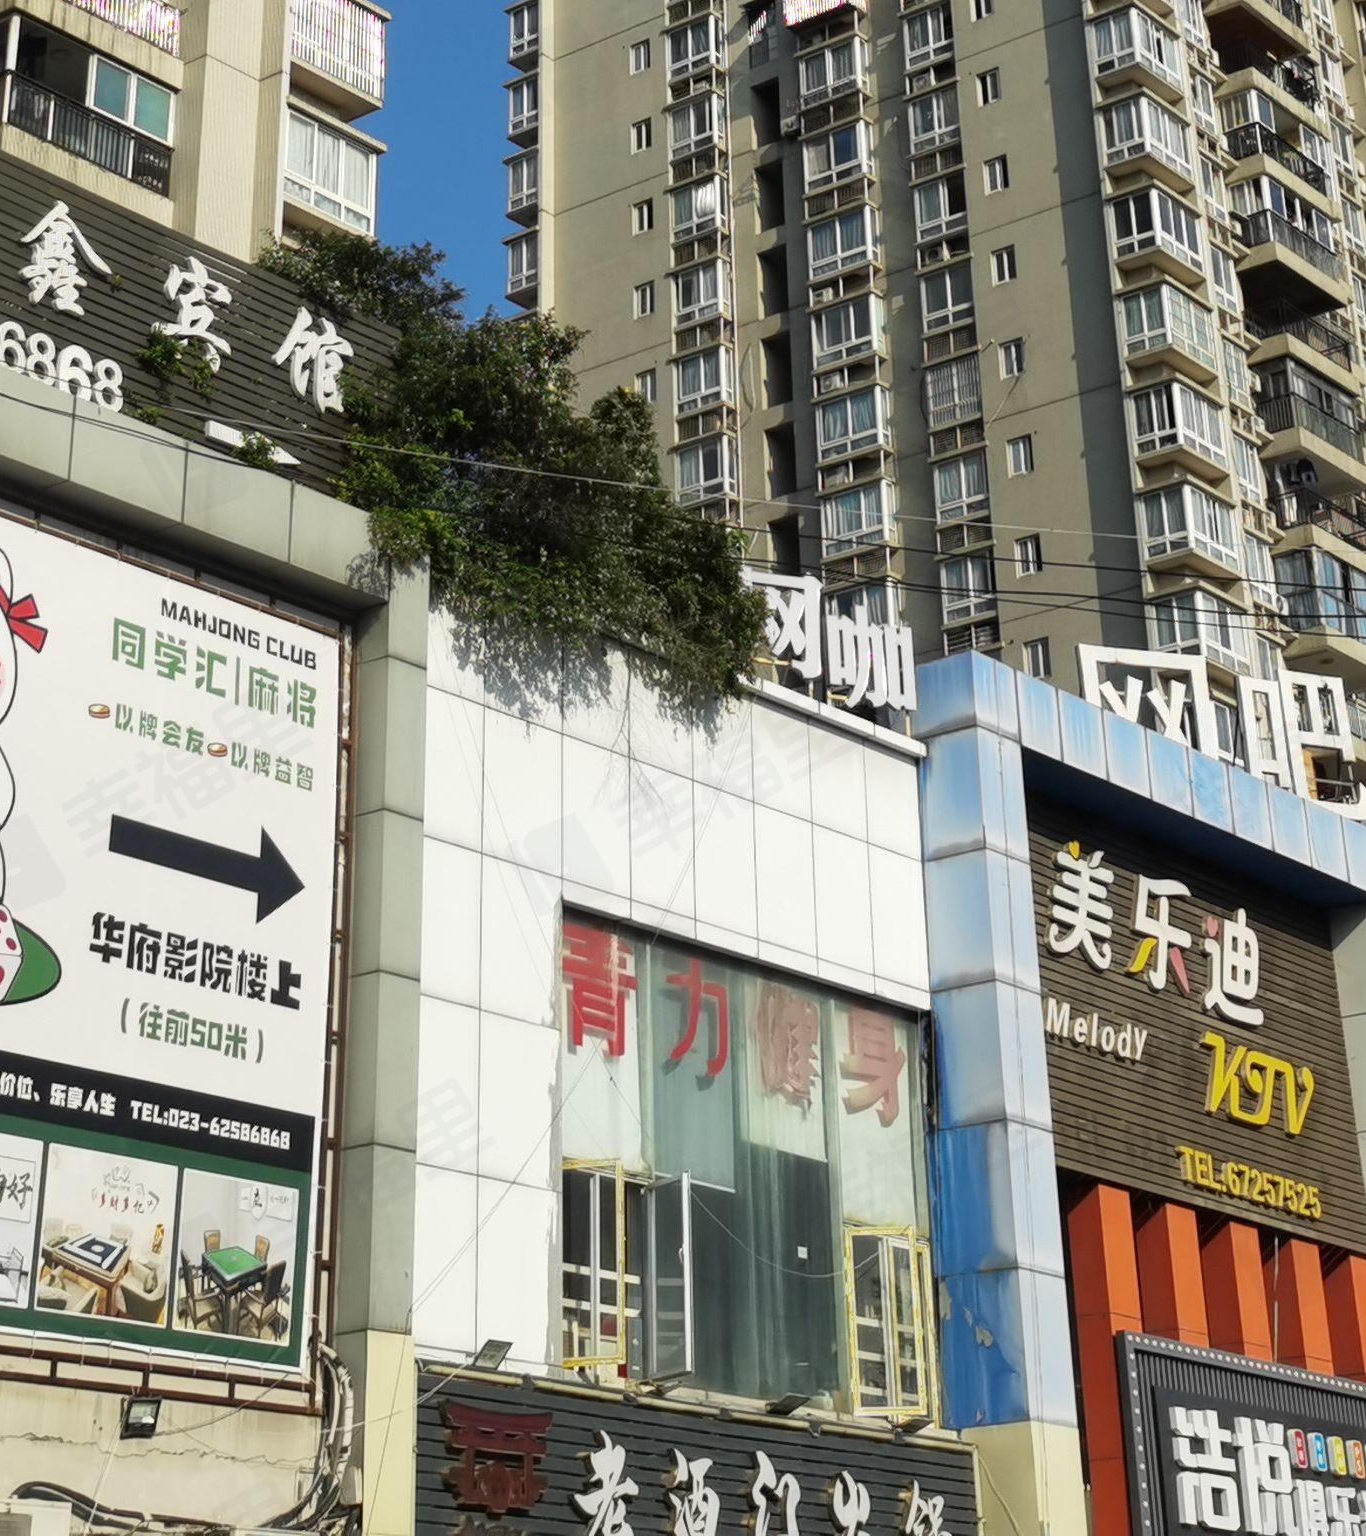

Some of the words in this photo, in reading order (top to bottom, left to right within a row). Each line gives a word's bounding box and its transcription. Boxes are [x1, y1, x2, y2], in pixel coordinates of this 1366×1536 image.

[161, 597, 260, 650] MAHJONG
[266, 636, 317, 670] CLUB
[740, 566, 918, 712] 网咖
[115, 702, 205, 756] 以牌会友
[231, 741, 314, 792] 以牌益智
[90, 911, 304, 1011] 华府影院楼上
[1045, 840, 1266, 1026] 美乐迪
[1200, 1030, 1315, 1135] KTV
[1176, 1145, 1323, 1220] TEL:67257525
